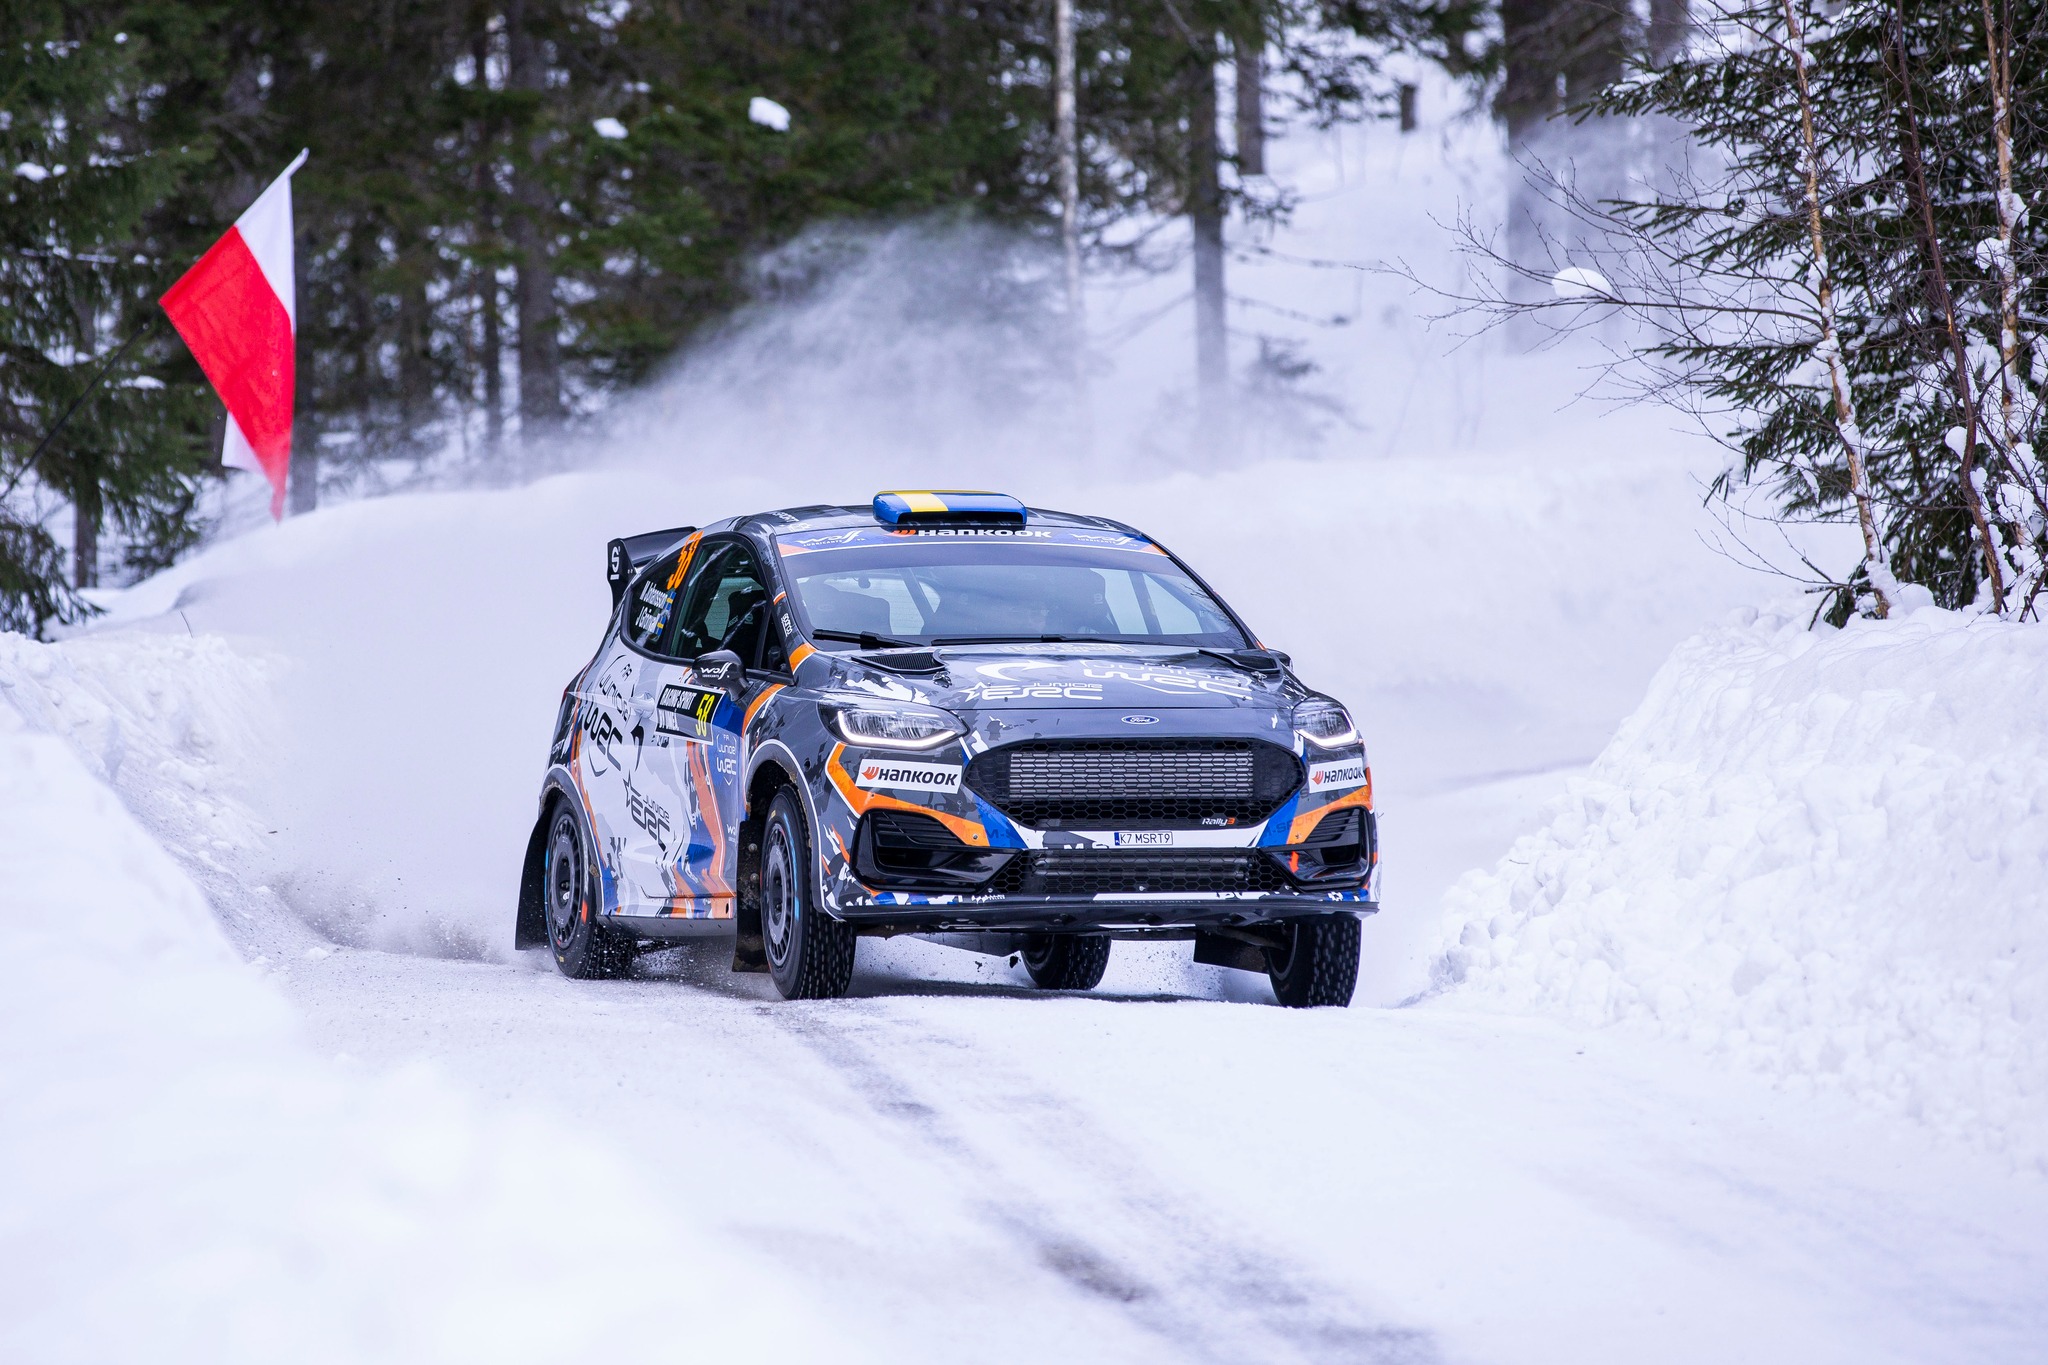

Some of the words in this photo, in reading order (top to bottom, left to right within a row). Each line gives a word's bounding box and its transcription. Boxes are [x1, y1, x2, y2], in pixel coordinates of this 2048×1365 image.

[695, 693, 715, 737] 58
[1120, 832, 1132, 844] K7
[1135, 832, 1171, 844] MSRT9
